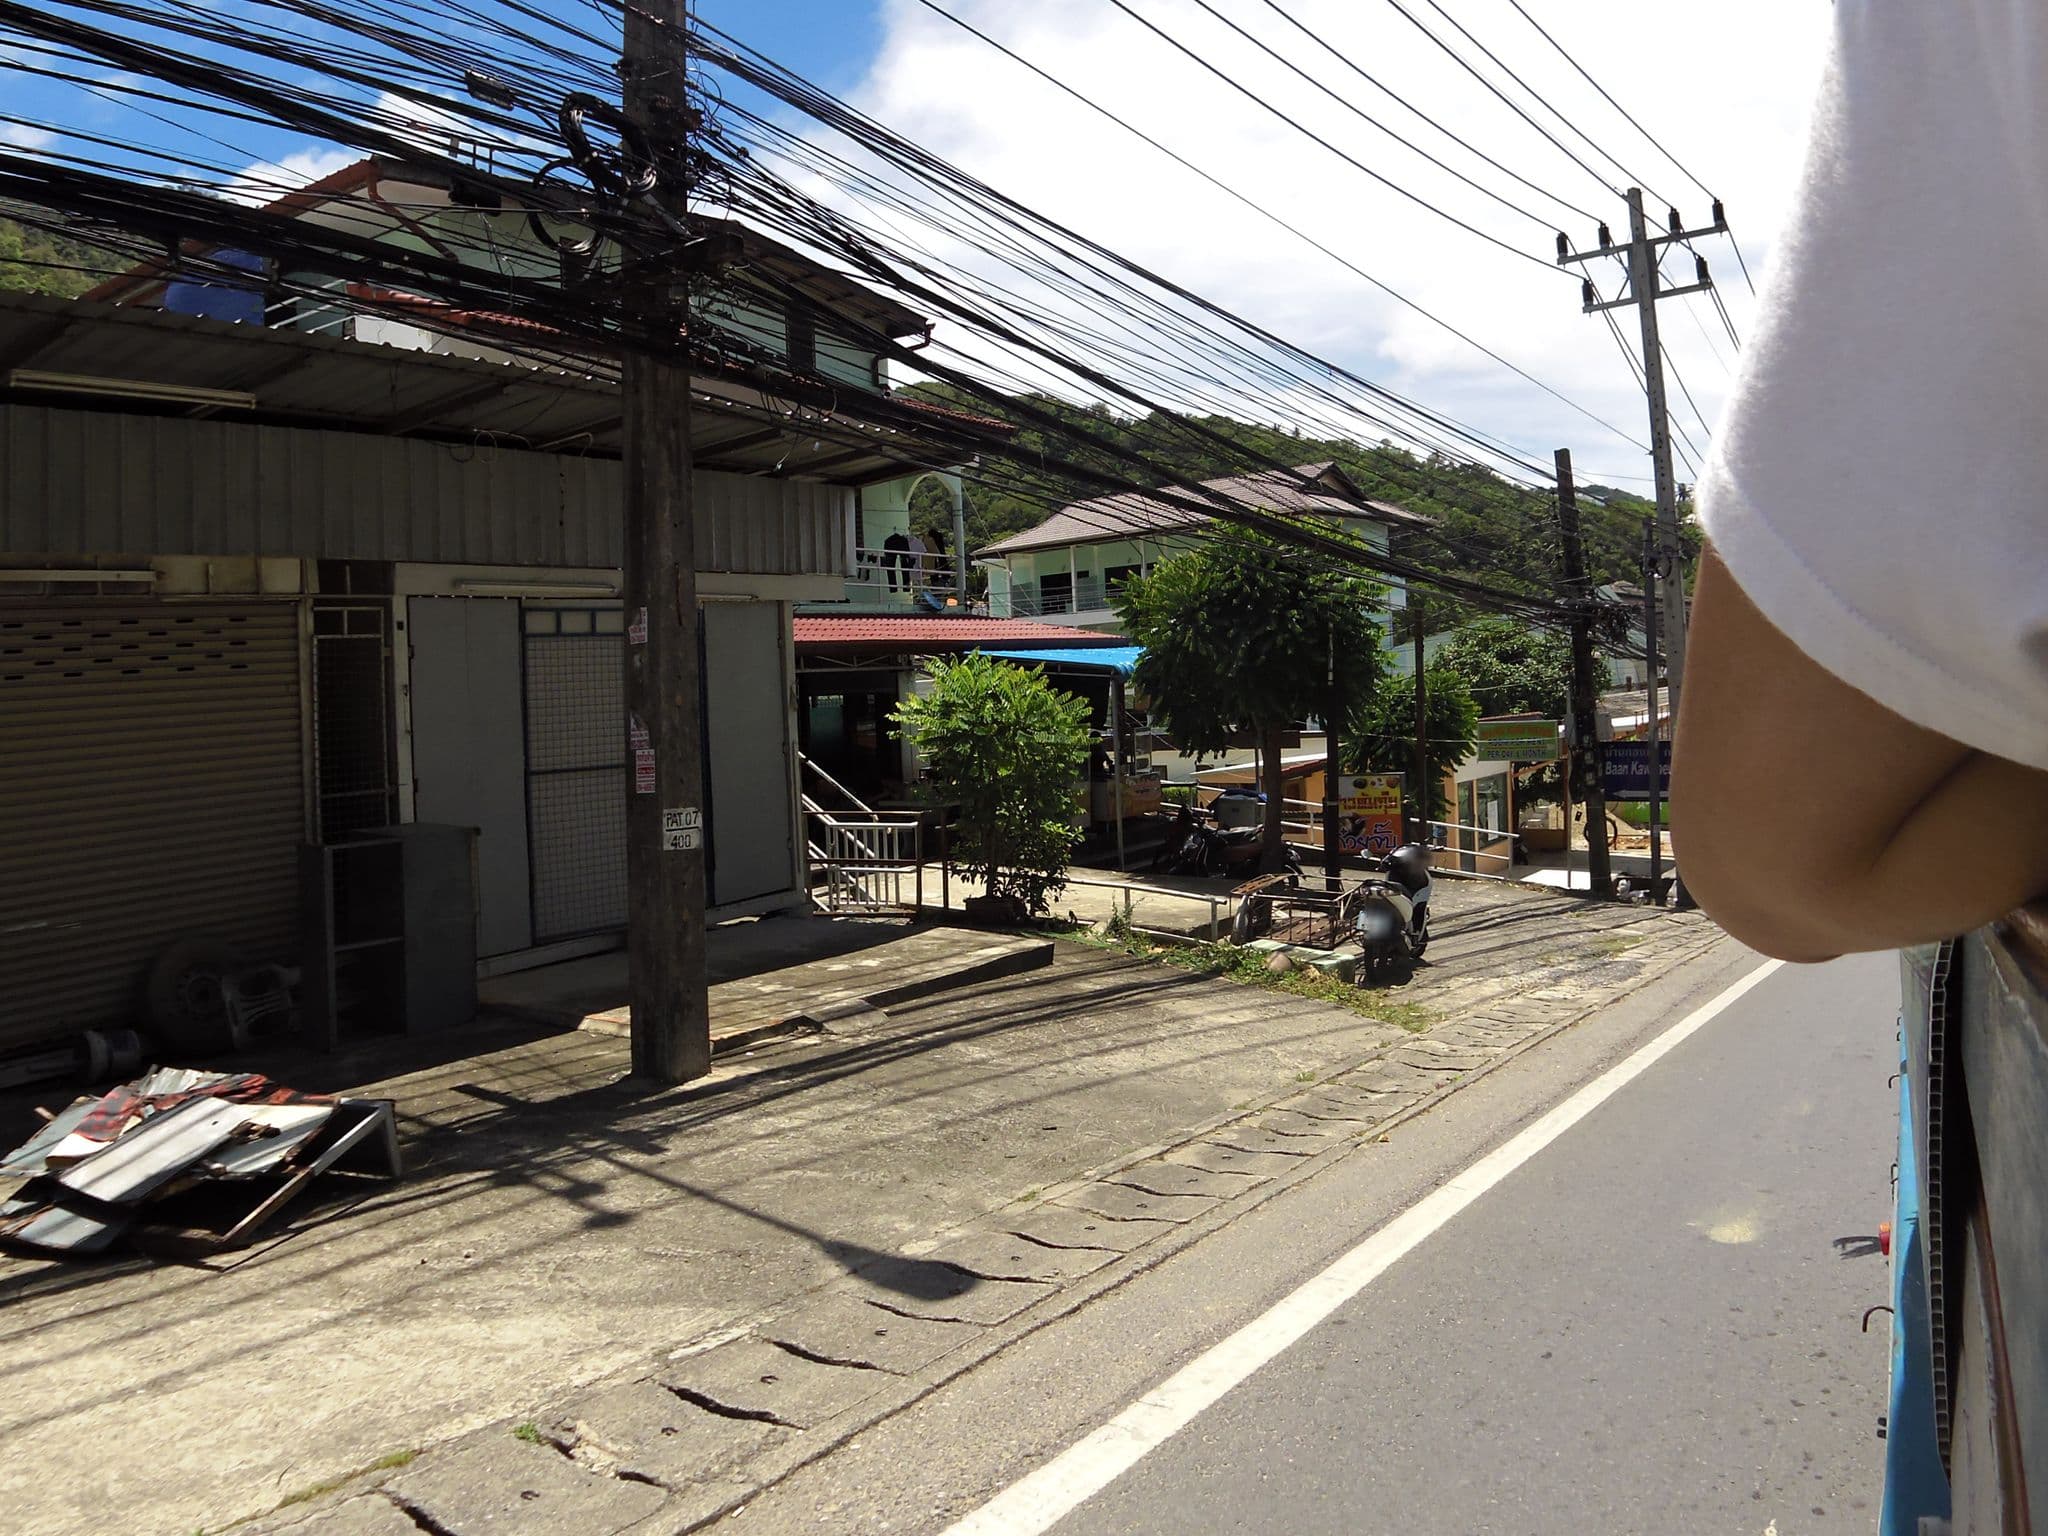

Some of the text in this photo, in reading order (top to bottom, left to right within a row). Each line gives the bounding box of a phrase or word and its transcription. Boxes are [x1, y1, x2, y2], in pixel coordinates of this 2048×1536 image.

[1605, 761, 1629, 775] Baan
[666, 810, 699, 828] PAT 07
[670, 834, 691, 848] 400
